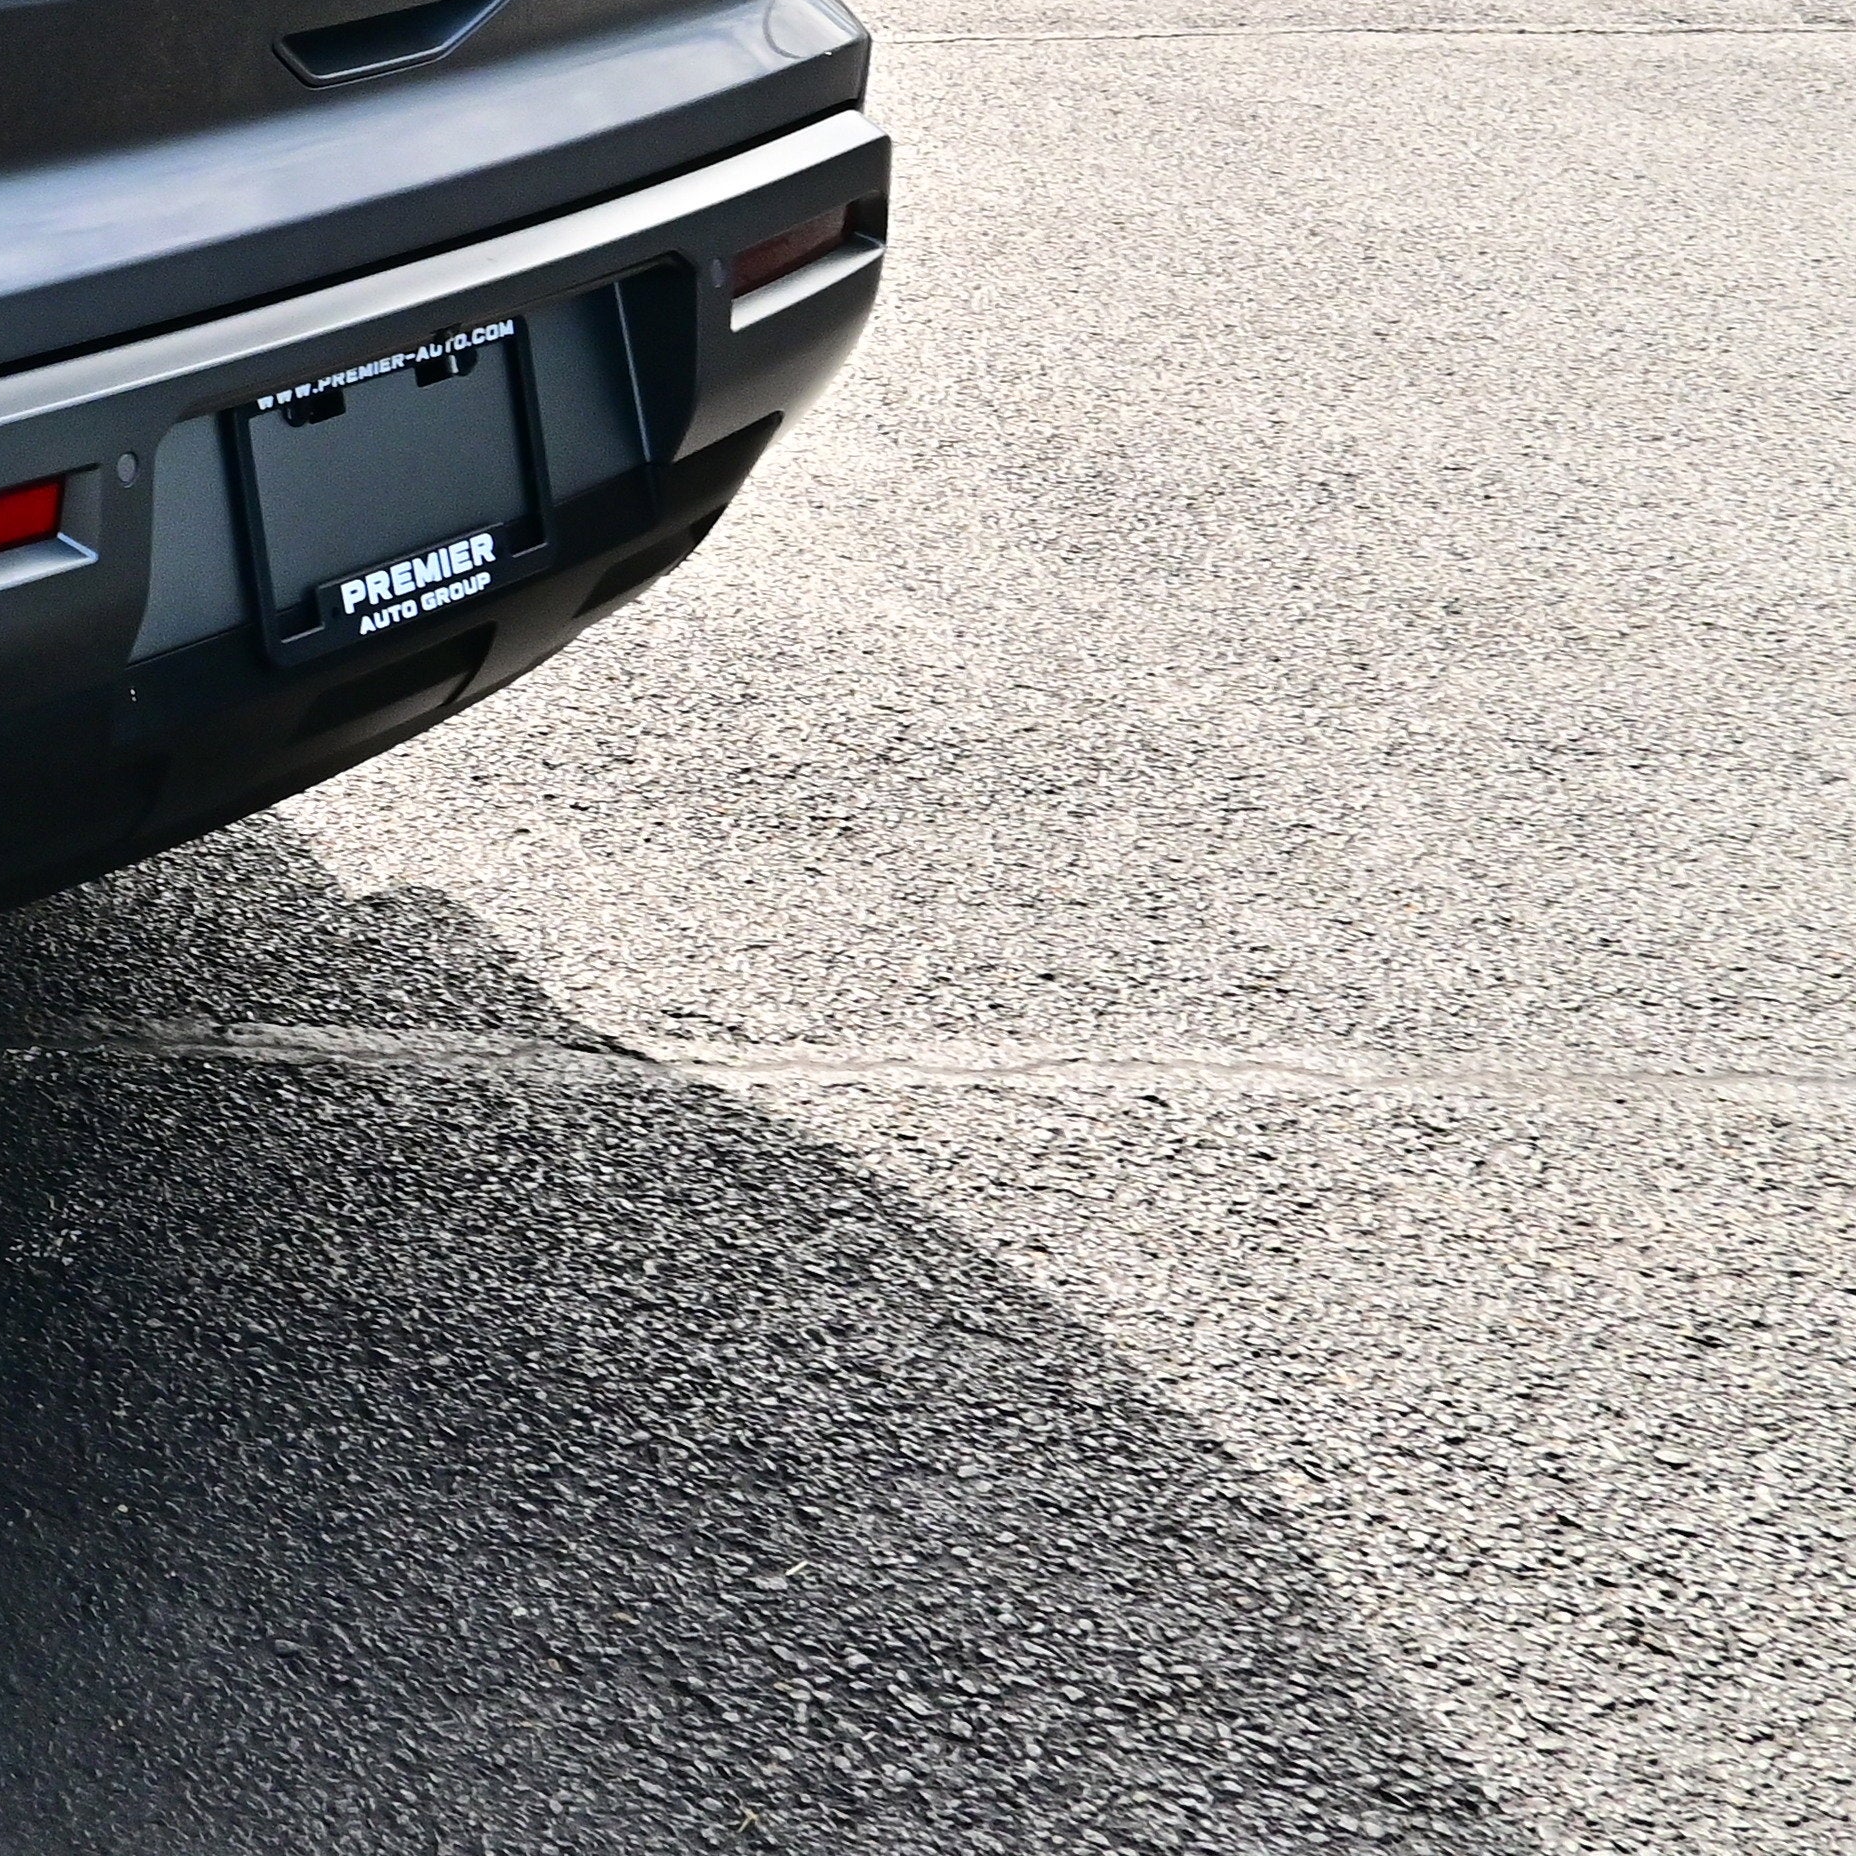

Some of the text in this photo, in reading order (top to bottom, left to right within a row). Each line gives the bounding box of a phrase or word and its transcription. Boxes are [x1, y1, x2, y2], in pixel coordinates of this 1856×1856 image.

[256, 319, 515, 411] WWW.PREMIER-AUTO.COM
[340, 532, 496, 615] PREMIER
[359, 571, 491, 636] AUTO GROUP
